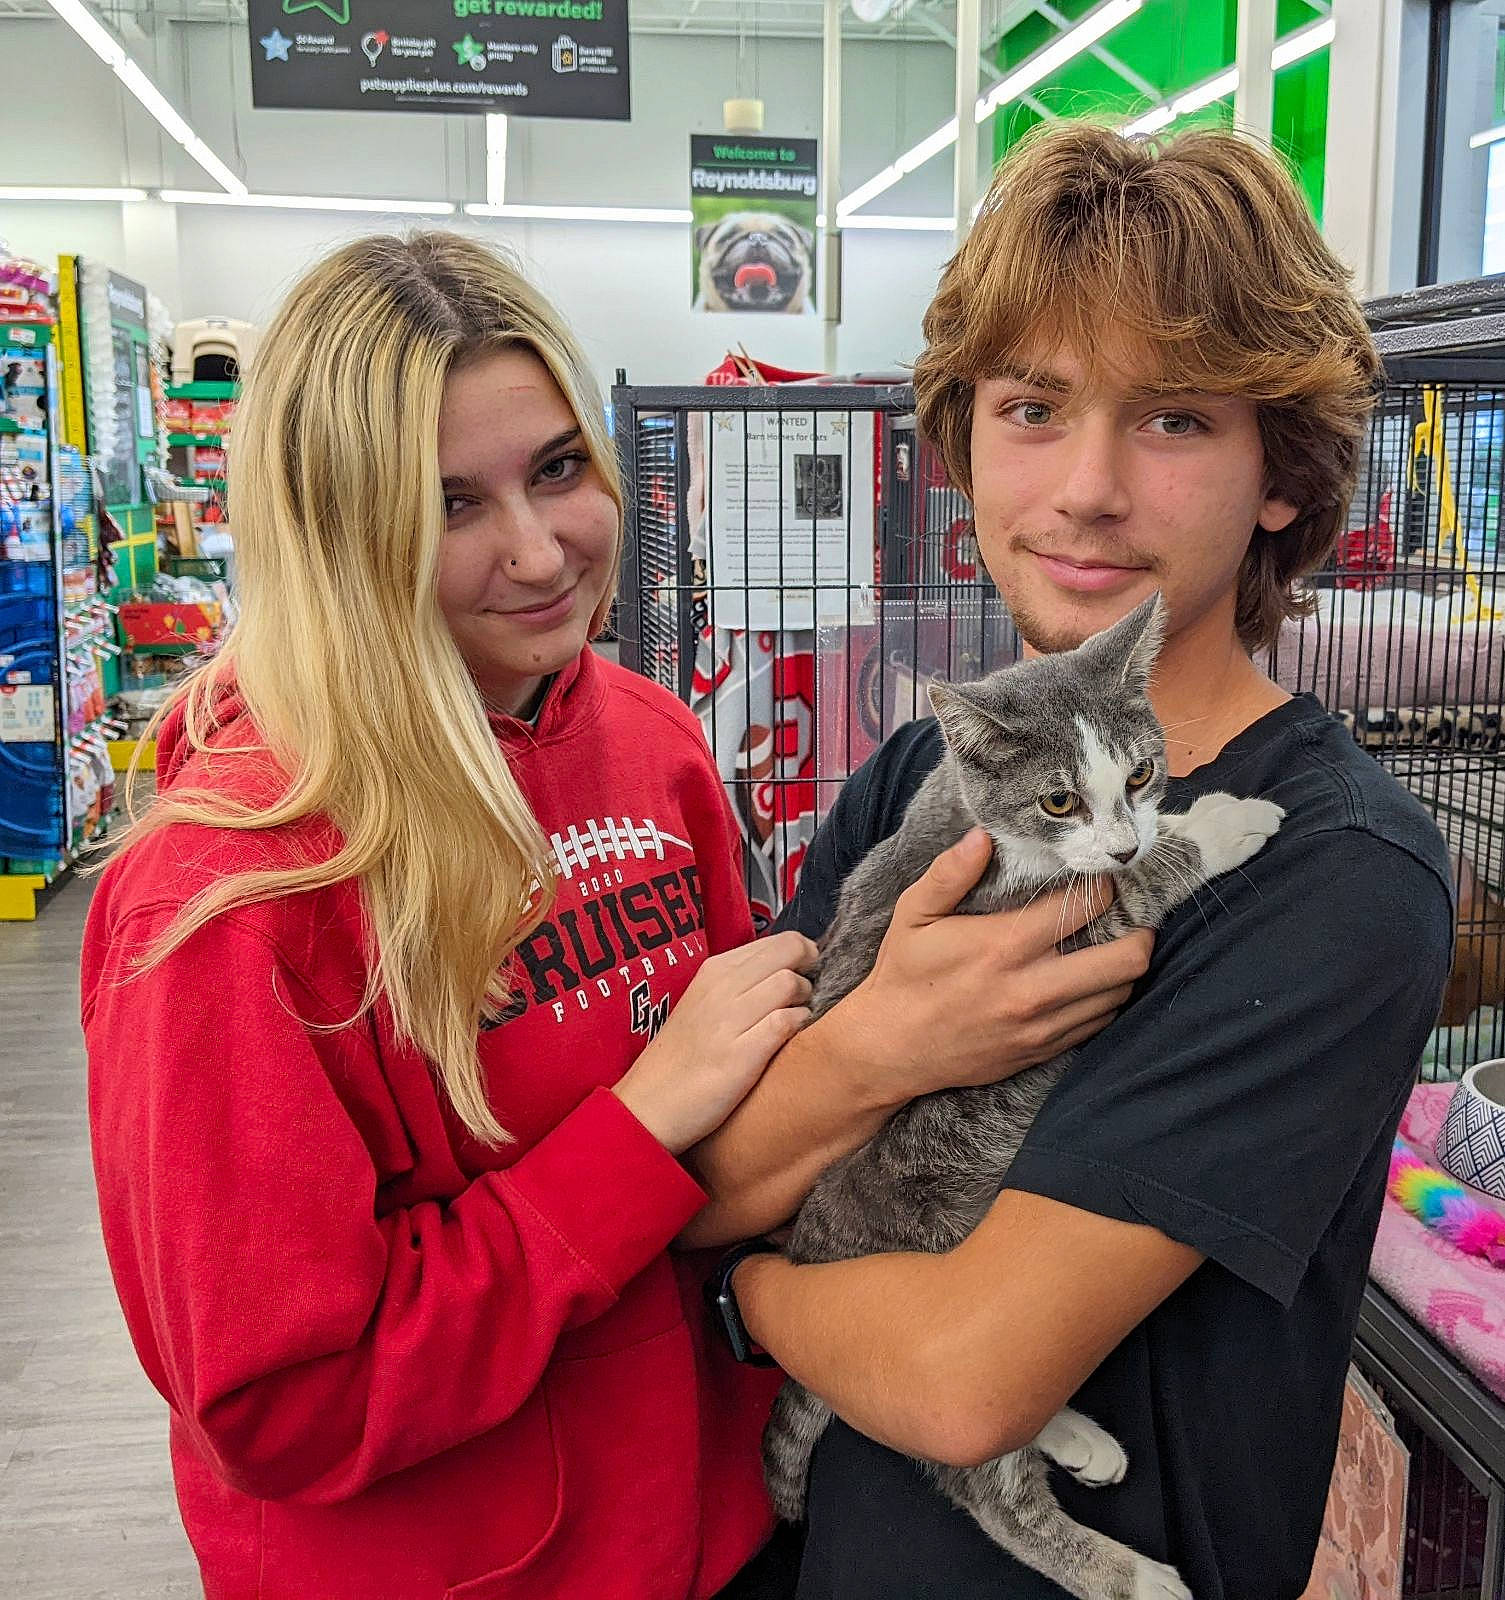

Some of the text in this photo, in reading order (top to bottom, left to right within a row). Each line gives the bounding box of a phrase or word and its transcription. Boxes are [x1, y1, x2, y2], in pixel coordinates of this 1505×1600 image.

[453, 0, 603, 20] get rewarded!
[360, 77, 529, 97] petsuppliesplus.com/rewards
[713, 145, 796, 162] Welcome to
[692, 169, 817, 195] Reynoldsburg
[767, 417, 807, 426] WANTED
[578, 868, 624, 897] 2020
[552, 936, 703, 1023] FOOTBALL
[630, 979, 670, 1045] GM
